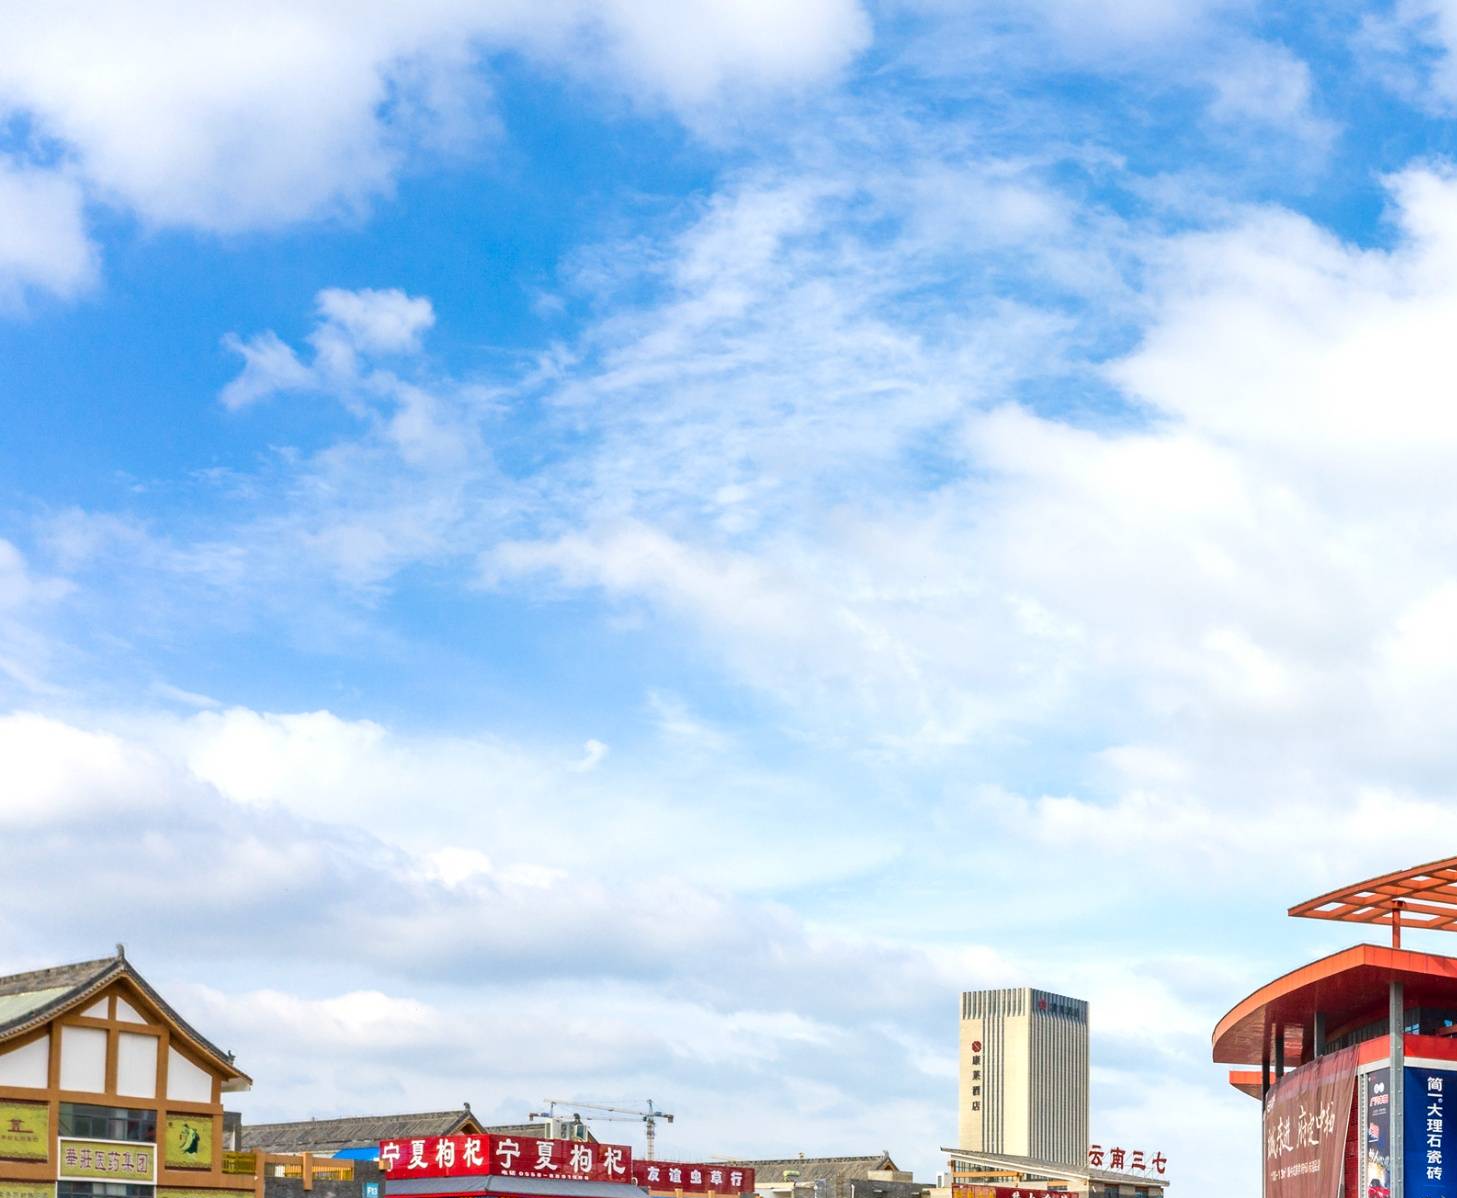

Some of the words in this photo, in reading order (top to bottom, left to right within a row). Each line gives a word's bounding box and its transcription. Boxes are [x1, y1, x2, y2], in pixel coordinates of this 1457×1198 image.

[381, 1138, 484, 1171] 宁夏枸杞
[496, 1138, 626, 1175] 宁夏枸杞
[1088, 1144, 1167, 1174] 云南三七
[647, 1166, 743, 1187] 友谊虫草行
